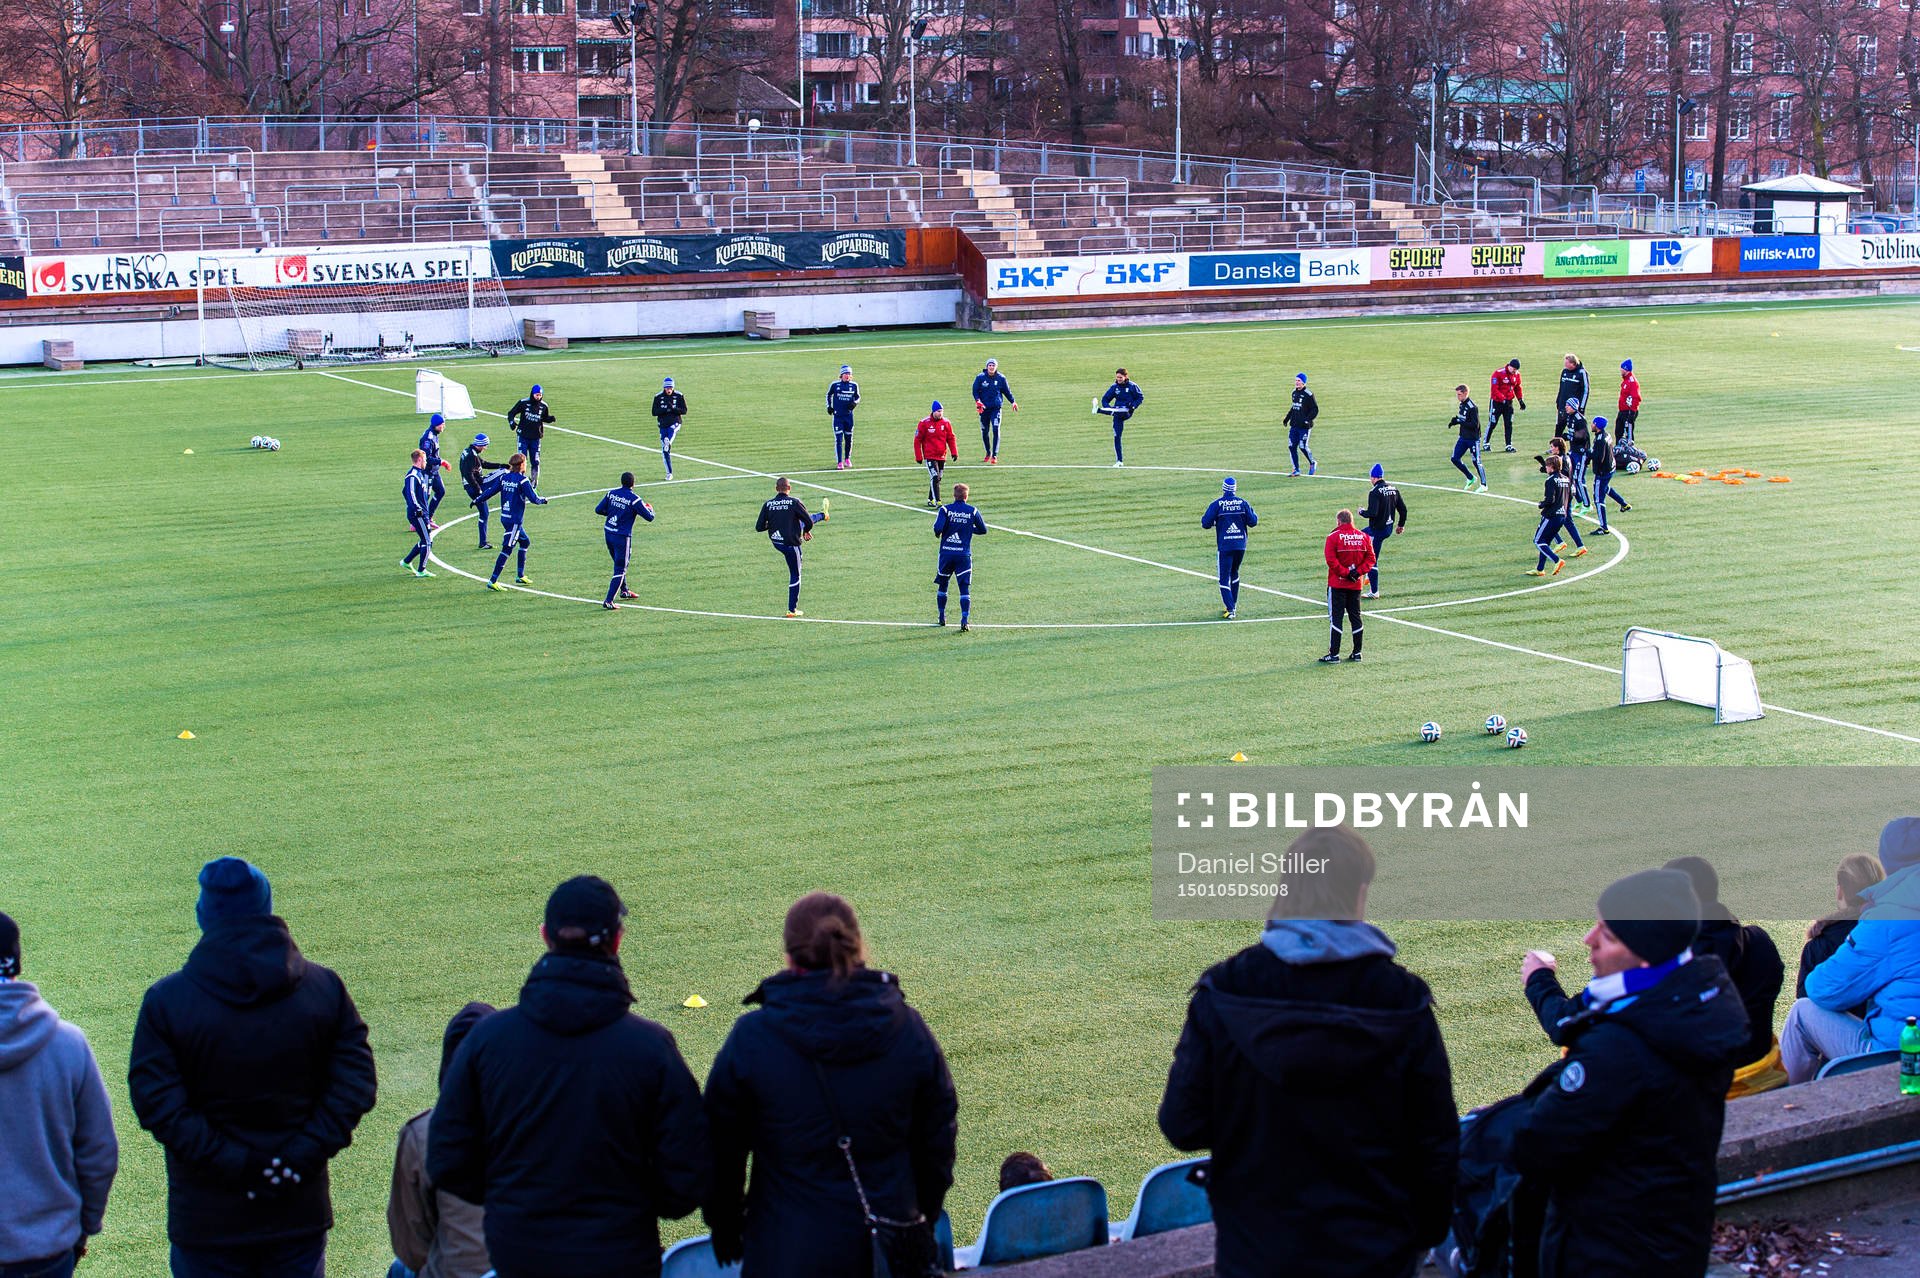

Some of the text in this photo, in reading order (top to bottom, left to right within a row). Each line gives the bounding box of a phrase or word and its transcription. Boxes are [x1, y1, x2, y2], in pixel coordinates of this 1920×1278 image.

[511, 247, 585, 272] KOPPARBERG
[607, 244, 679, 268] KOPPARBERG
[716, 241, 785, 265] KOPPARBERG
[821, 239, 889, 263] KOPPARBERG
[1390, 247, 1445, 270] SPORT
[1471, 245, 1525, 268] SPORT
[1743, 247, 1816, 261] Nilfisk-ALTO
[72, 268, 245, 292] SVENSKA SPEL
[313, 259, 476, 282] SVENSKA SPEL
[997, 265, 1069, 289] SKF
[1105, 262, 1176, 285] SKF
[1214, 259, 1360, 280] Danske Bank
[1392, 270, 1442, 278] BLADET
[1473, 267, 1523, 275] BLADET
